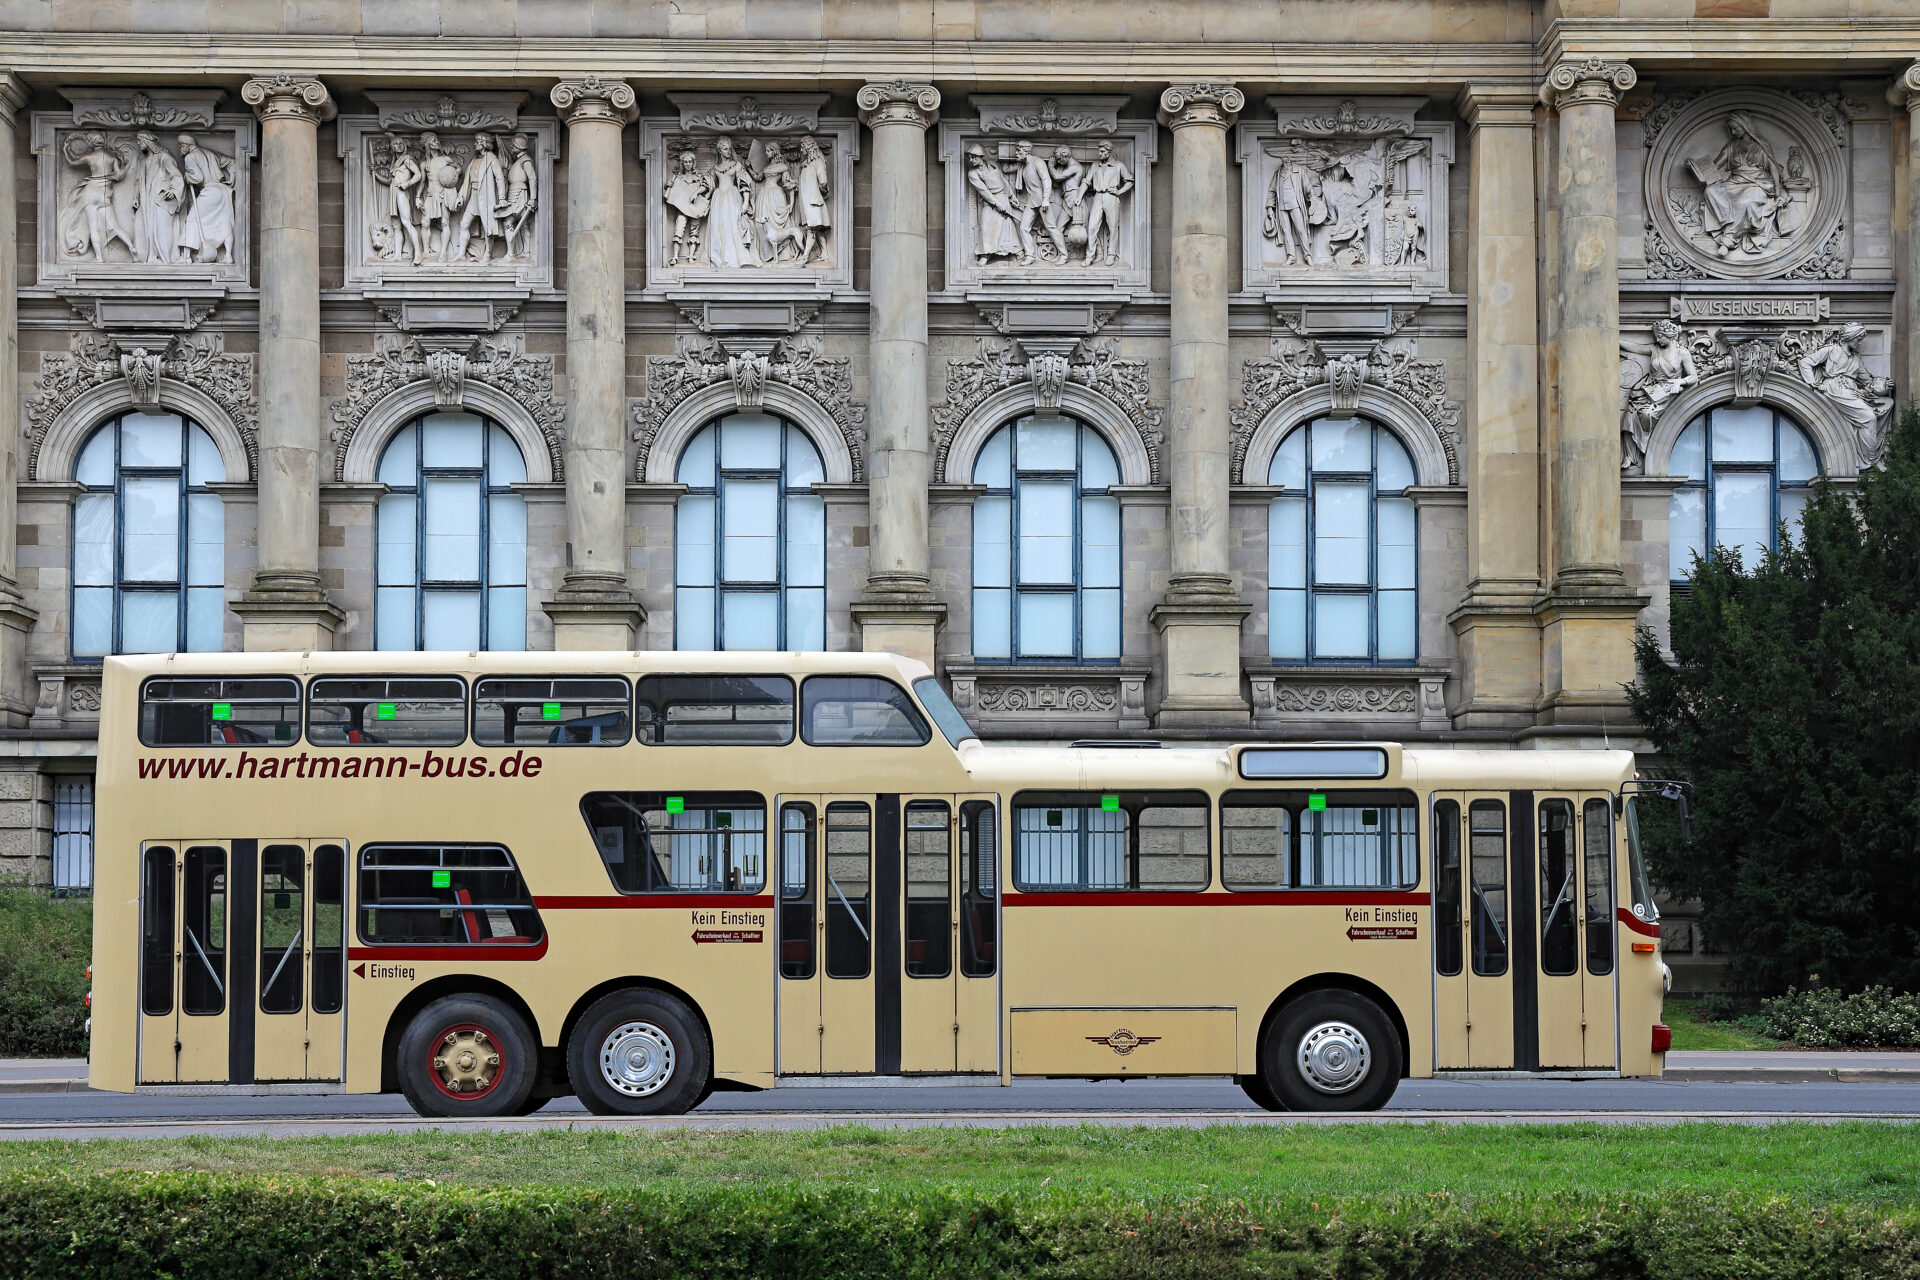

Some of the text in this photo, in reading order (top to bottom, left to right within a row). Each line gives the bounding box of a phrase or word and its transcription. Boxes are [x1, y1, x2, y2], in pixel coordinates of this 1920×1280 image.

[1686, 300, 1815, 316] WISSENSCHAFT
[138, 750, 543, 780] www.hartmann-bus.de
[691, 911, 765, 927] Kein Einstieg
[1345, 908, 1418, 924] Kein Einstieg
[371, 964, 415, 981] Einstieg
